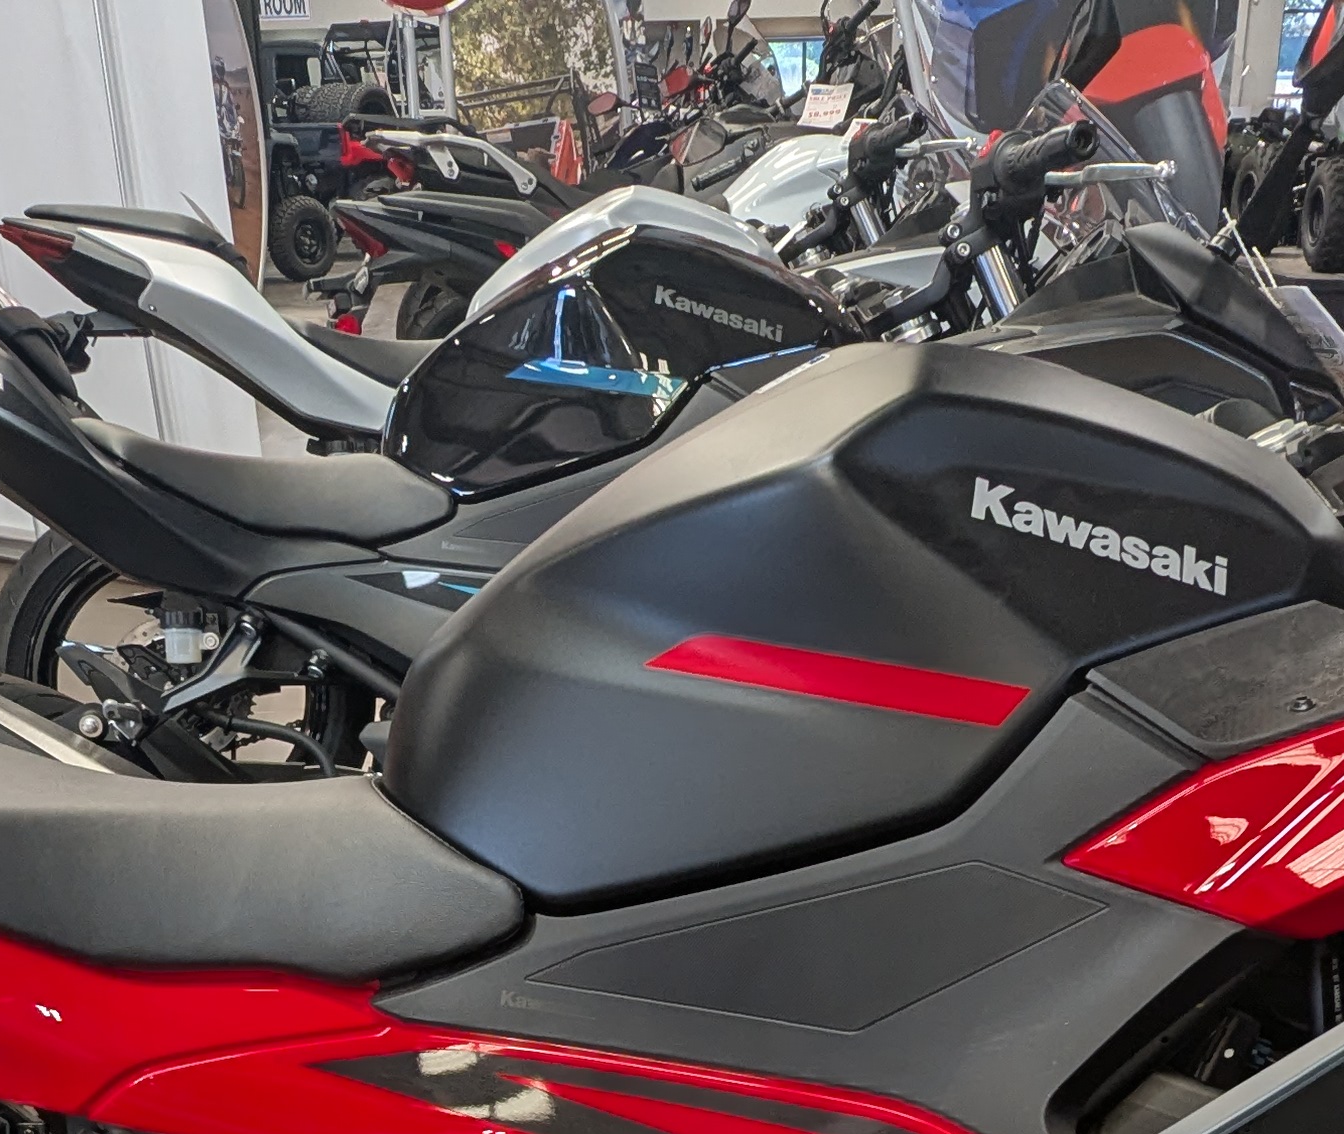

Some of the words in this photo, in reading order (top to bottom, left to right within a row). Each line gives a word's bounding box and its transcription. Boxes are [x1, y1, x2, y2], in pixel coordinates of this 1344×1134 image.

[263, 0, 307, 15] ROOM
[654, 284, 784, 343] Kawasaki
[970, 476, 1229, 597] Kawasaki
